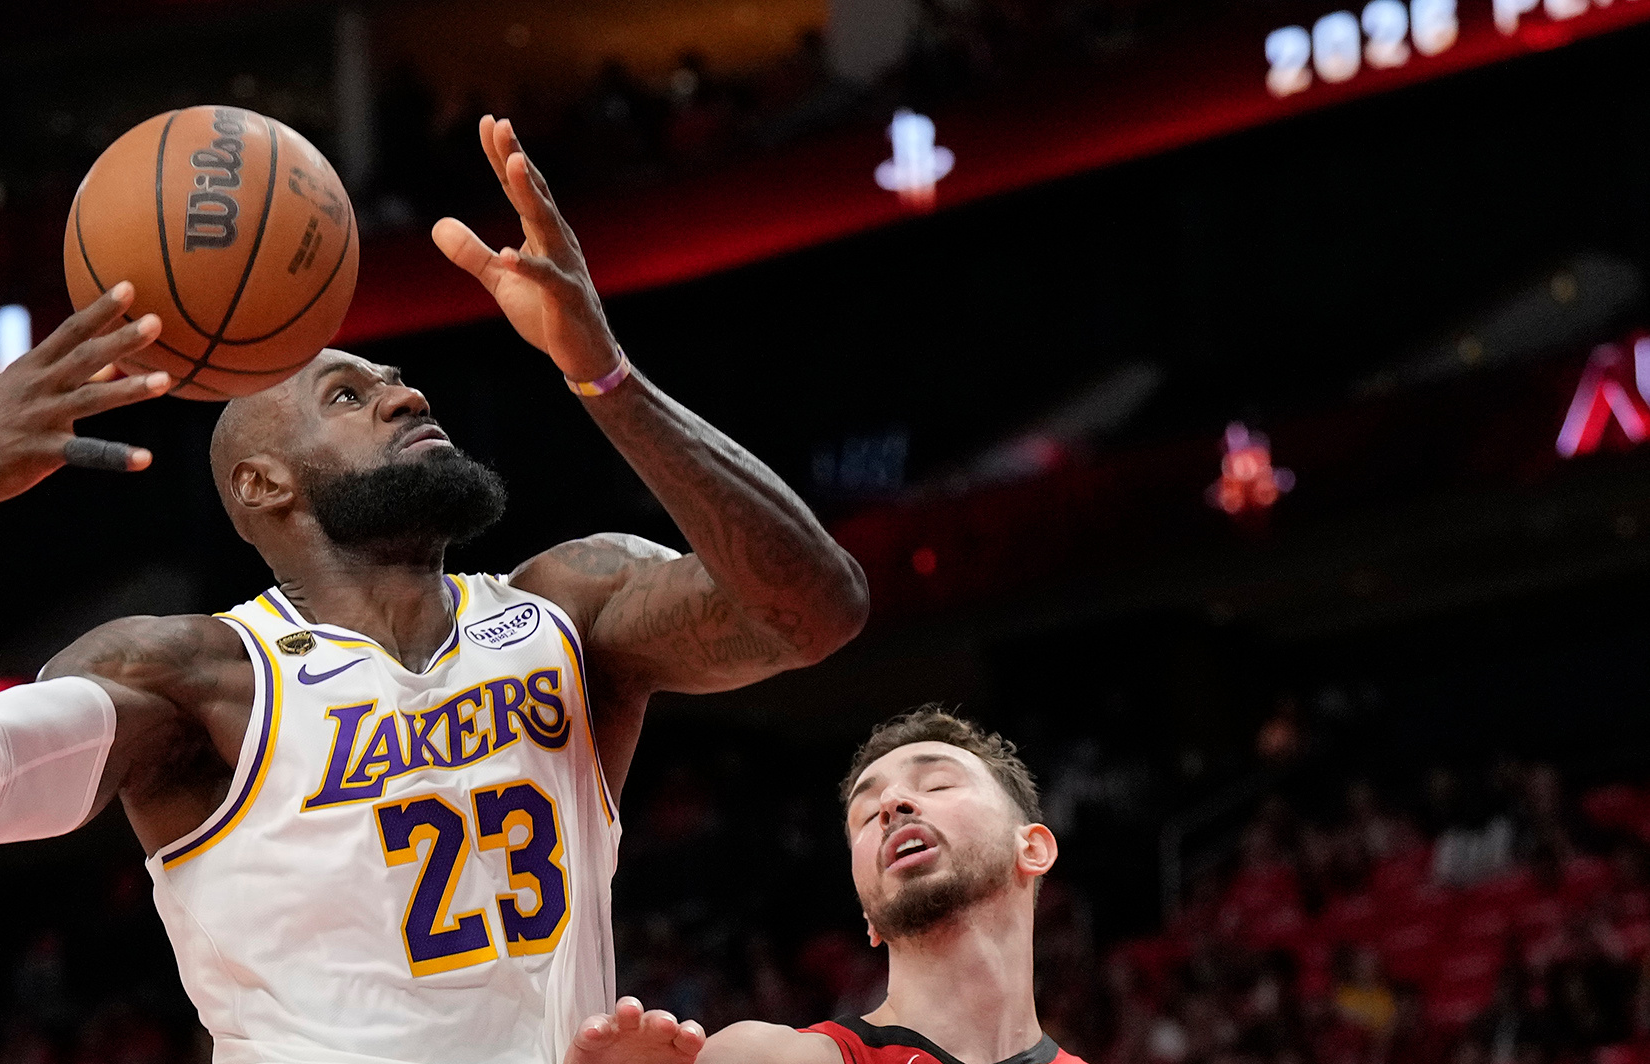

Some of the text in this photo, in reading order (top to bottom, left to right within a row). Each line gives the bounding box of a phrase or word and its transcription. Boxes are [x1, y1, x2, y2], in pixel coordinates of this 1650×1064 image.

[470, 608, 533, 640] bibigo
[300, 668, 571, 813] LAKERS
[372, 778, 571, 978] 23
